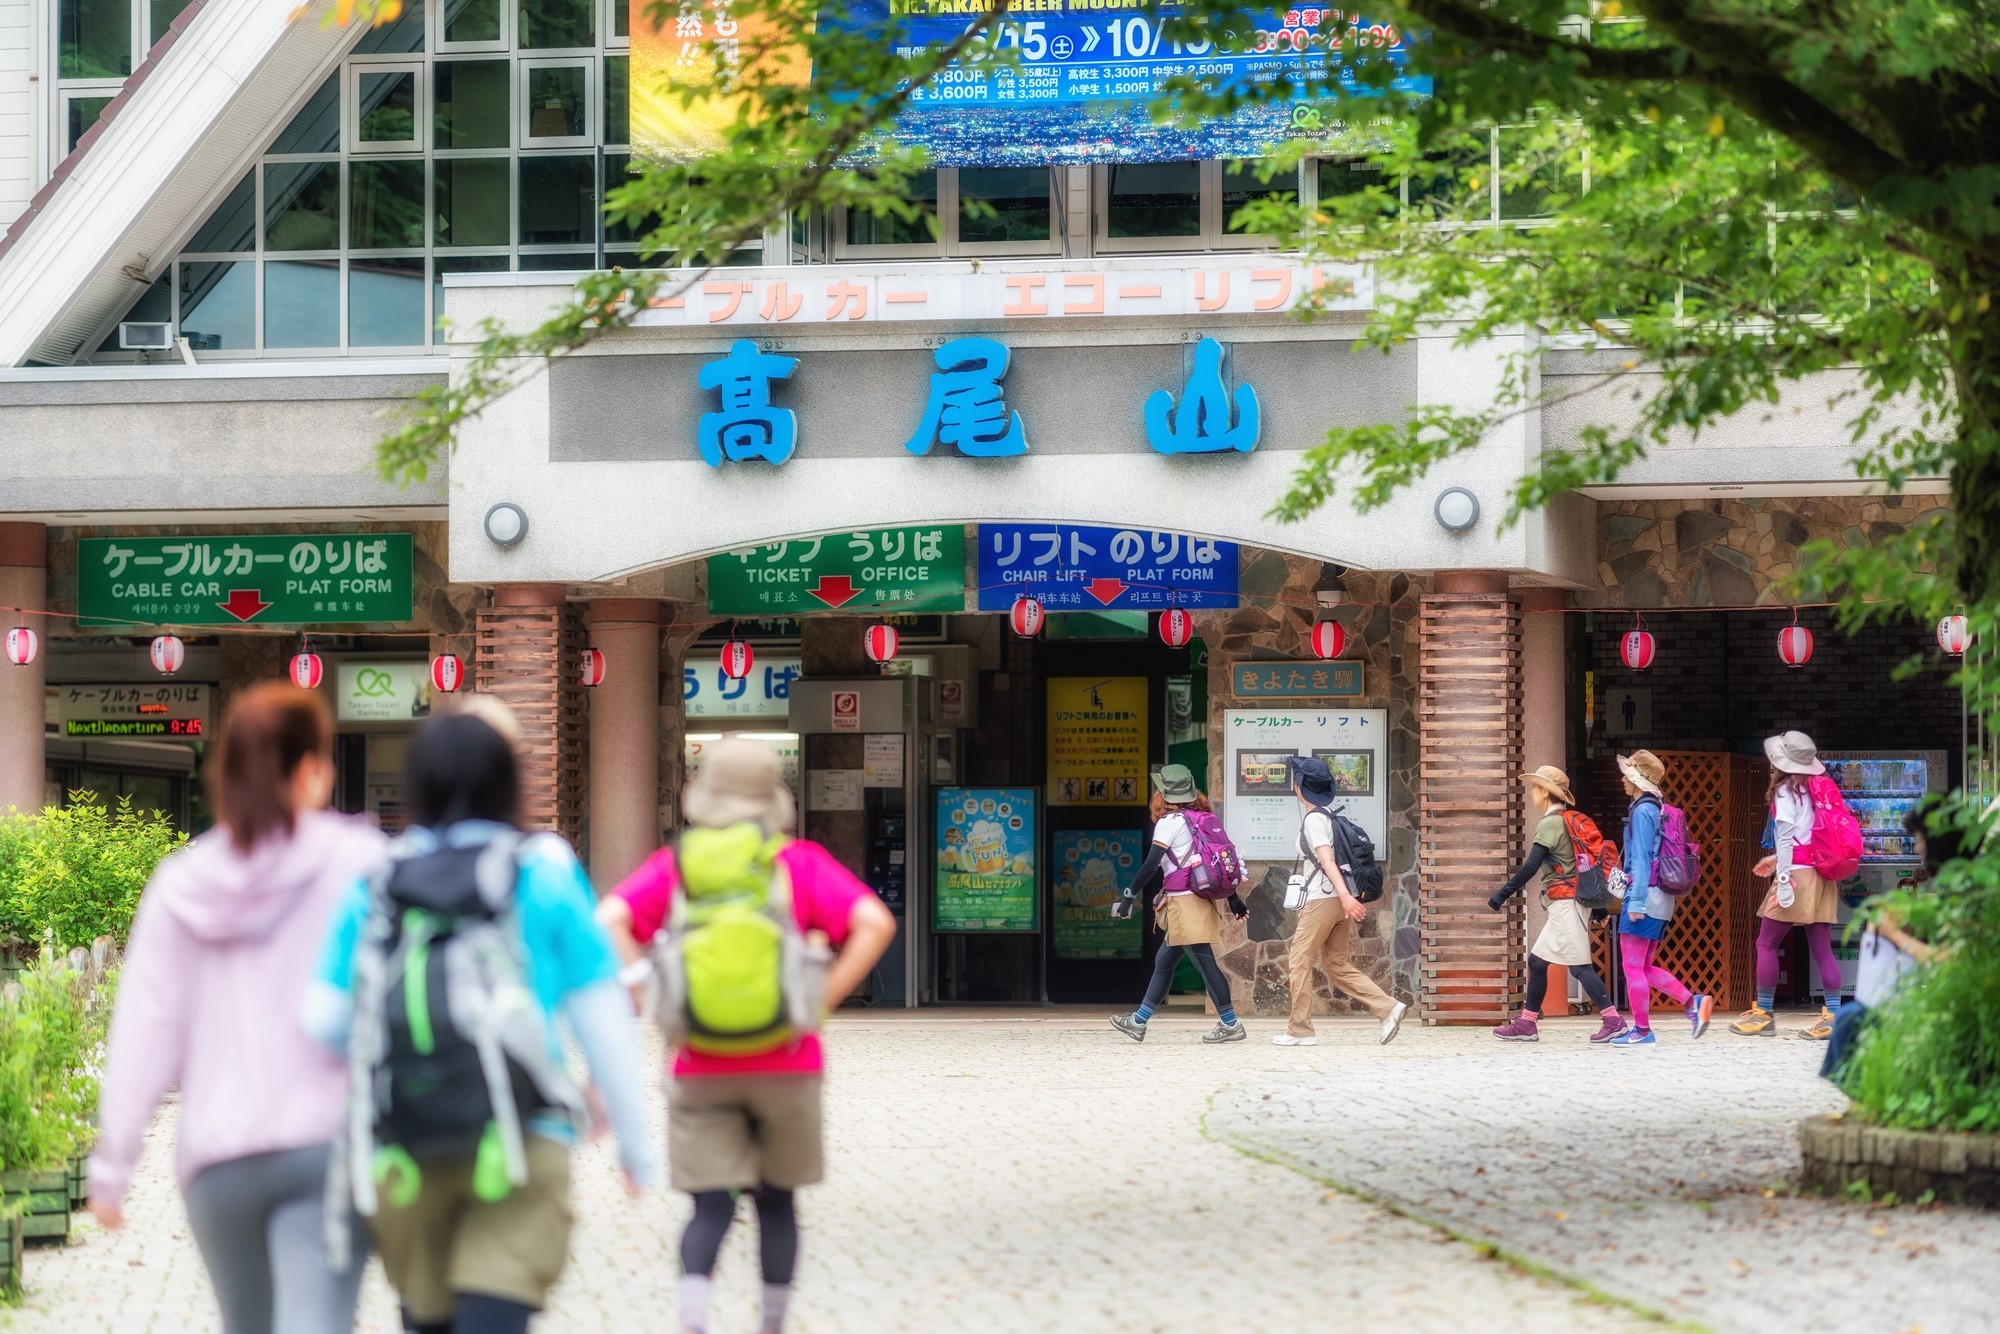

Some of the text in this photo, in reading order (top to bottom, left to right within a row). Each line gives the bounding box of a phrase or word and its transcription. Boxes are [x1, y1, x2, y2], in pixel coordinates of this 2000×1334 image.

[1068, 66, 1149, 80] 高校生 3,300円
[1152, 64, 1184, 77] 中学生
[1019, 78, 1059, 88] 3,500円
[1068, 81, 1149, 95] 小学生 1,500円
[997, 89, 1059, 99] 女性 3,300円
[849, 530, 943, 562] うりば
[994, 531, 1097, 566] リフト
[103, 540, 388, 578] ケーブルカーのりば
[746, 566, 929, 583] TICKET OFFICE
[1003, 568, 1214, 583] CHAIR LIFT PLAT FORM
[112, 579, 392, 597] CABLE CAR PLAT FORM
[759, 591, 799, 603] 매표소
[69, 687, 200, 703] ケーブルカーのりば
[1233, 716, 1370, 727] ケーブルカー リフト
